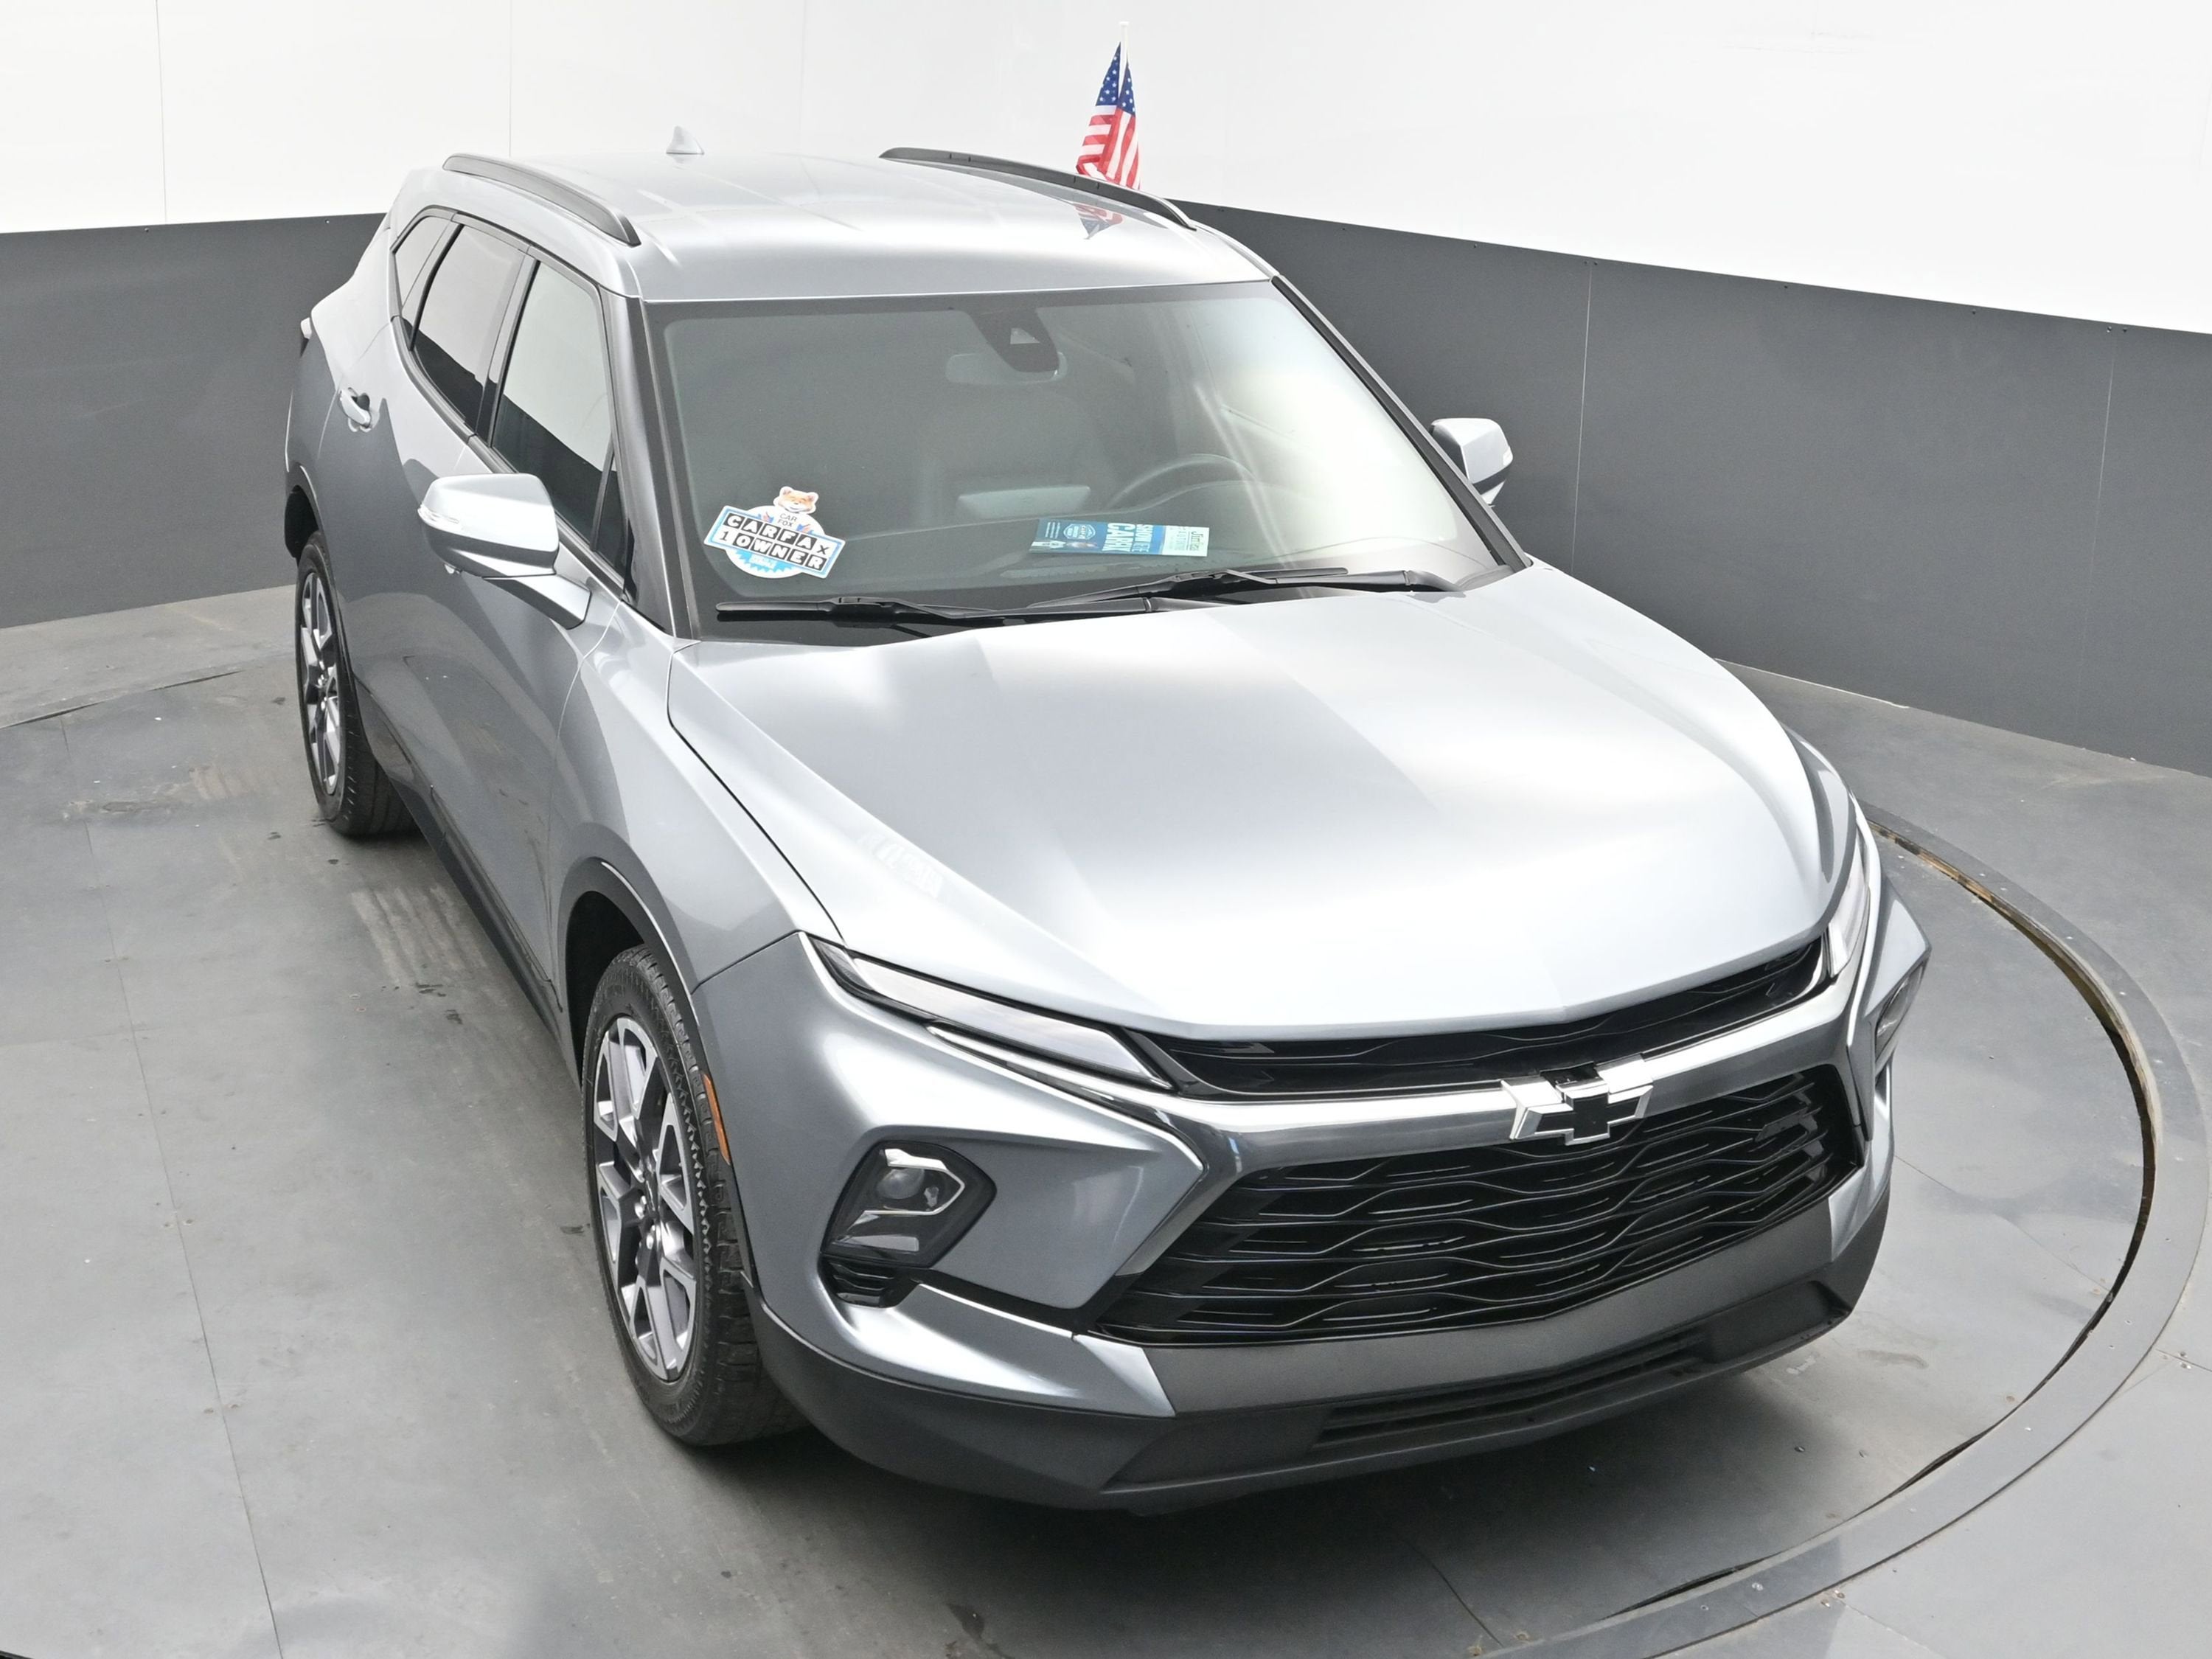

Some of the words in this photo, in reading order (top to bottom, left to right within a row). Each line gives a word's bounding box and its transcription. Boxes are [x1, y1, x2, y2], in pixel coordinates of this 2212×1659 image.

[777, 519, 794, 527] FOX
[779, 512, 798, 522] CAR
[724, 514, 830, 555] CARFAX
[718, 531, 730, 542] 1
[734, 533, 827, 570] OWNER
